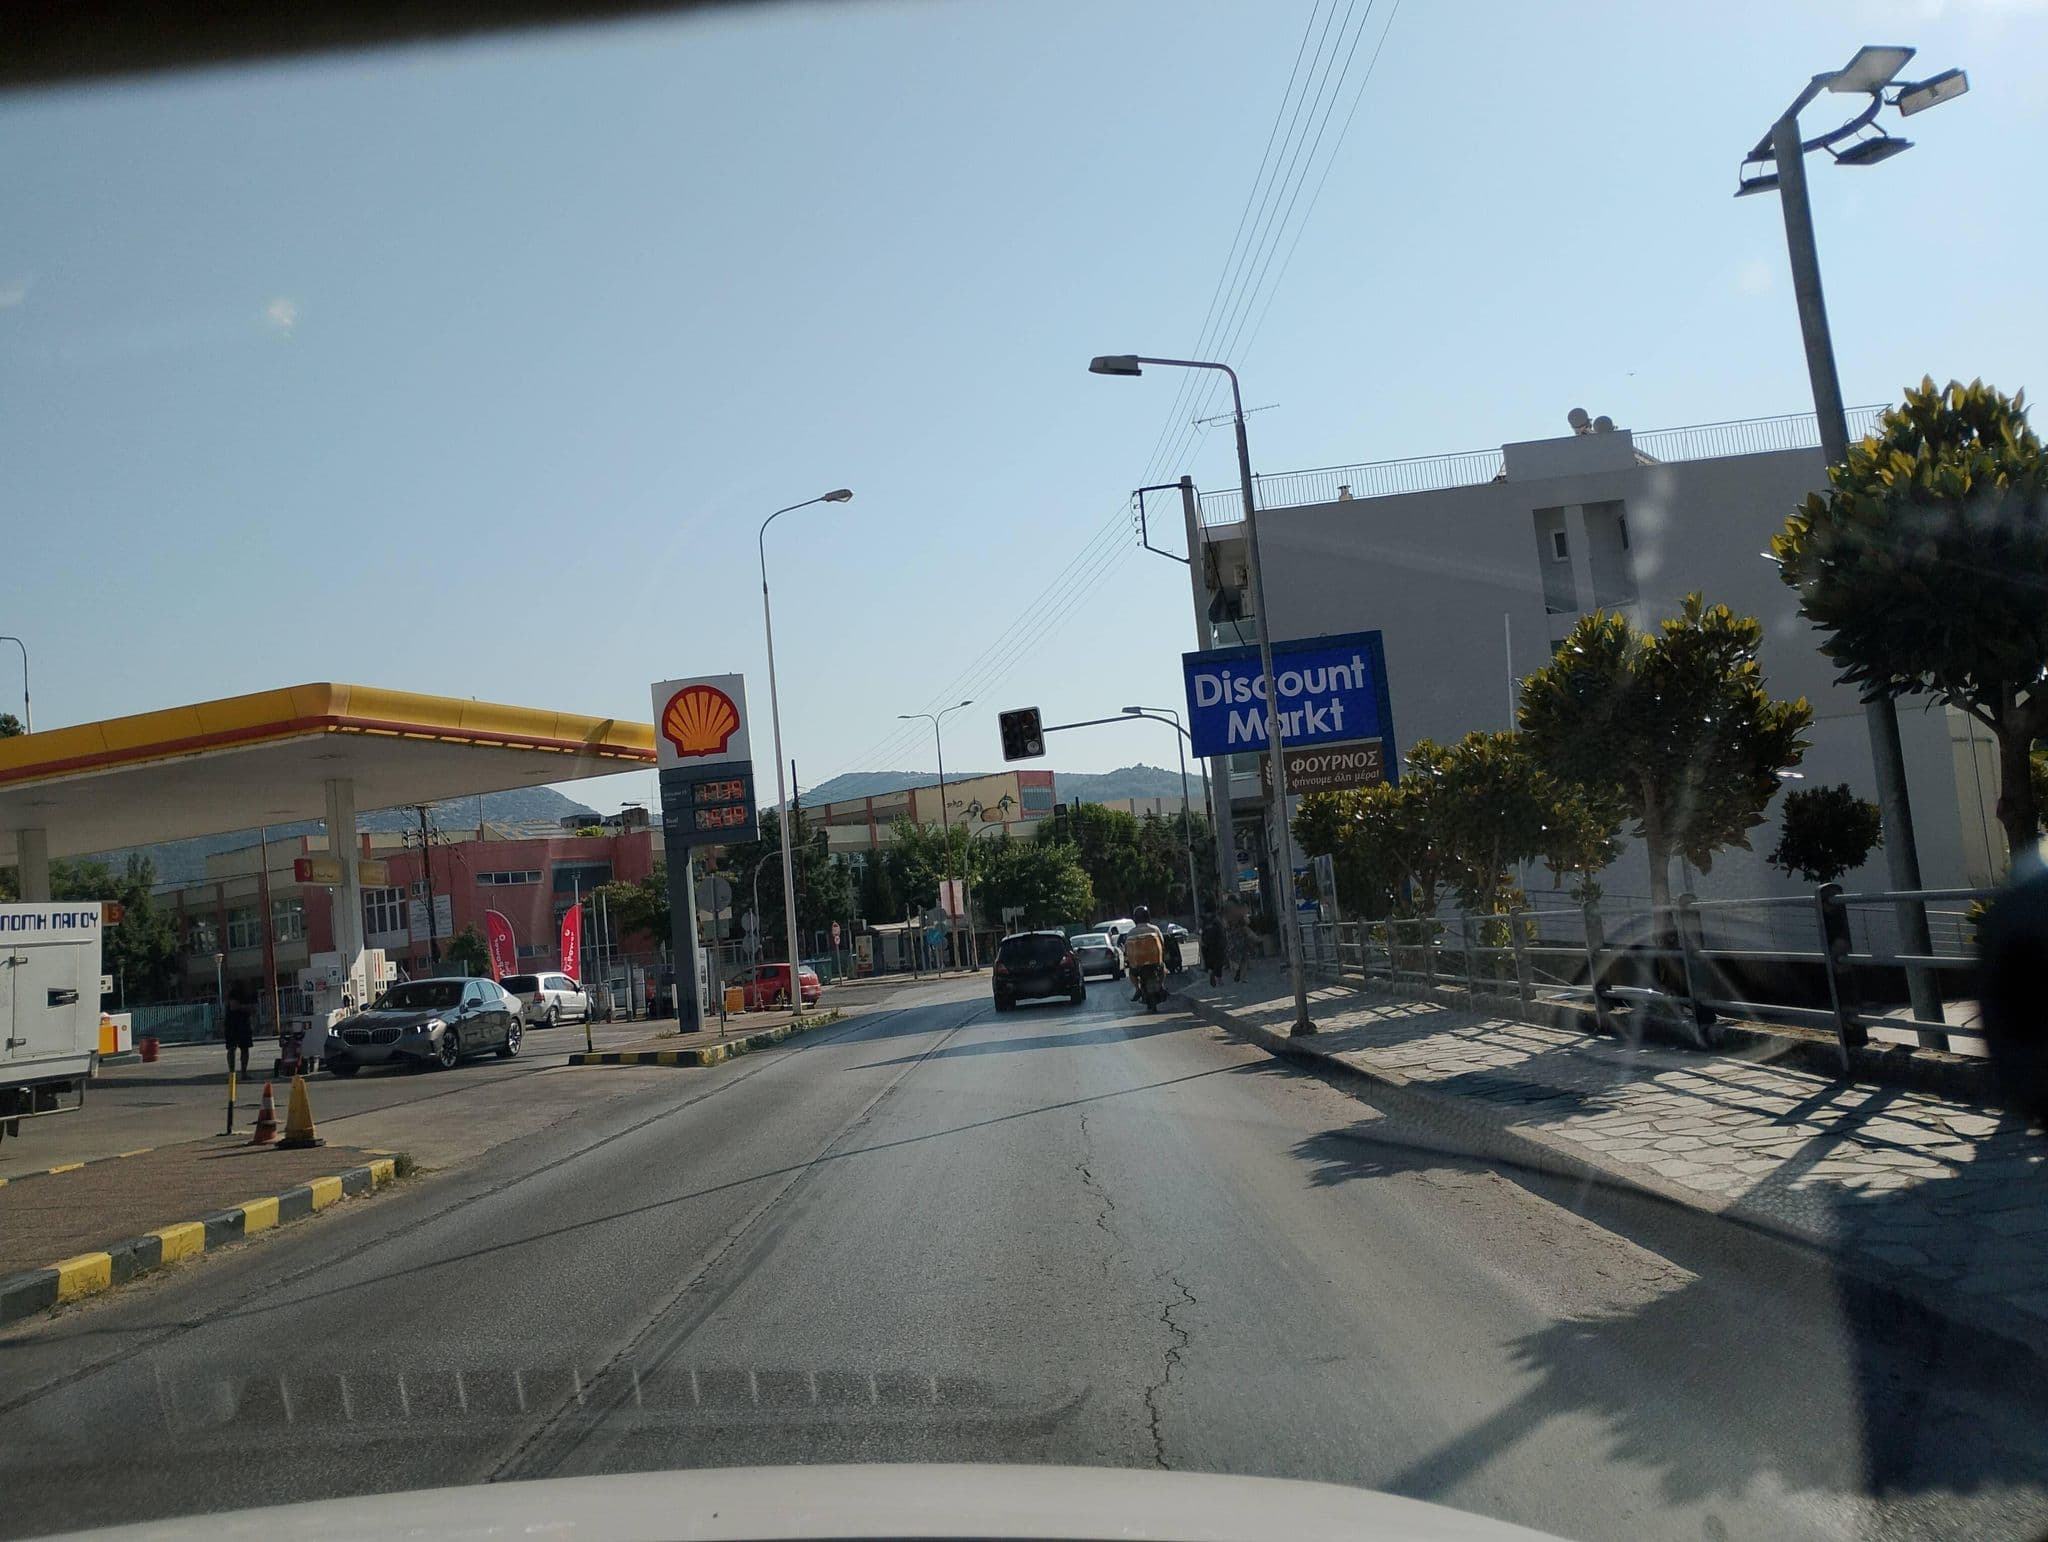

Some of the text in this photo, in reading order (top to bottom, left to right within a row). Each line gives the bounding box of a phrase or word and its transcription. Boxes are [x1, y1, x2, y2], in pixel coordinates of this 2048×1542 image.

[1194, 654, 1365, 708] Discount
[1227, 698, 1344, 744] Markt
[1290, 750, 1379, 775] ΦΟΥΡΝΟΣ
